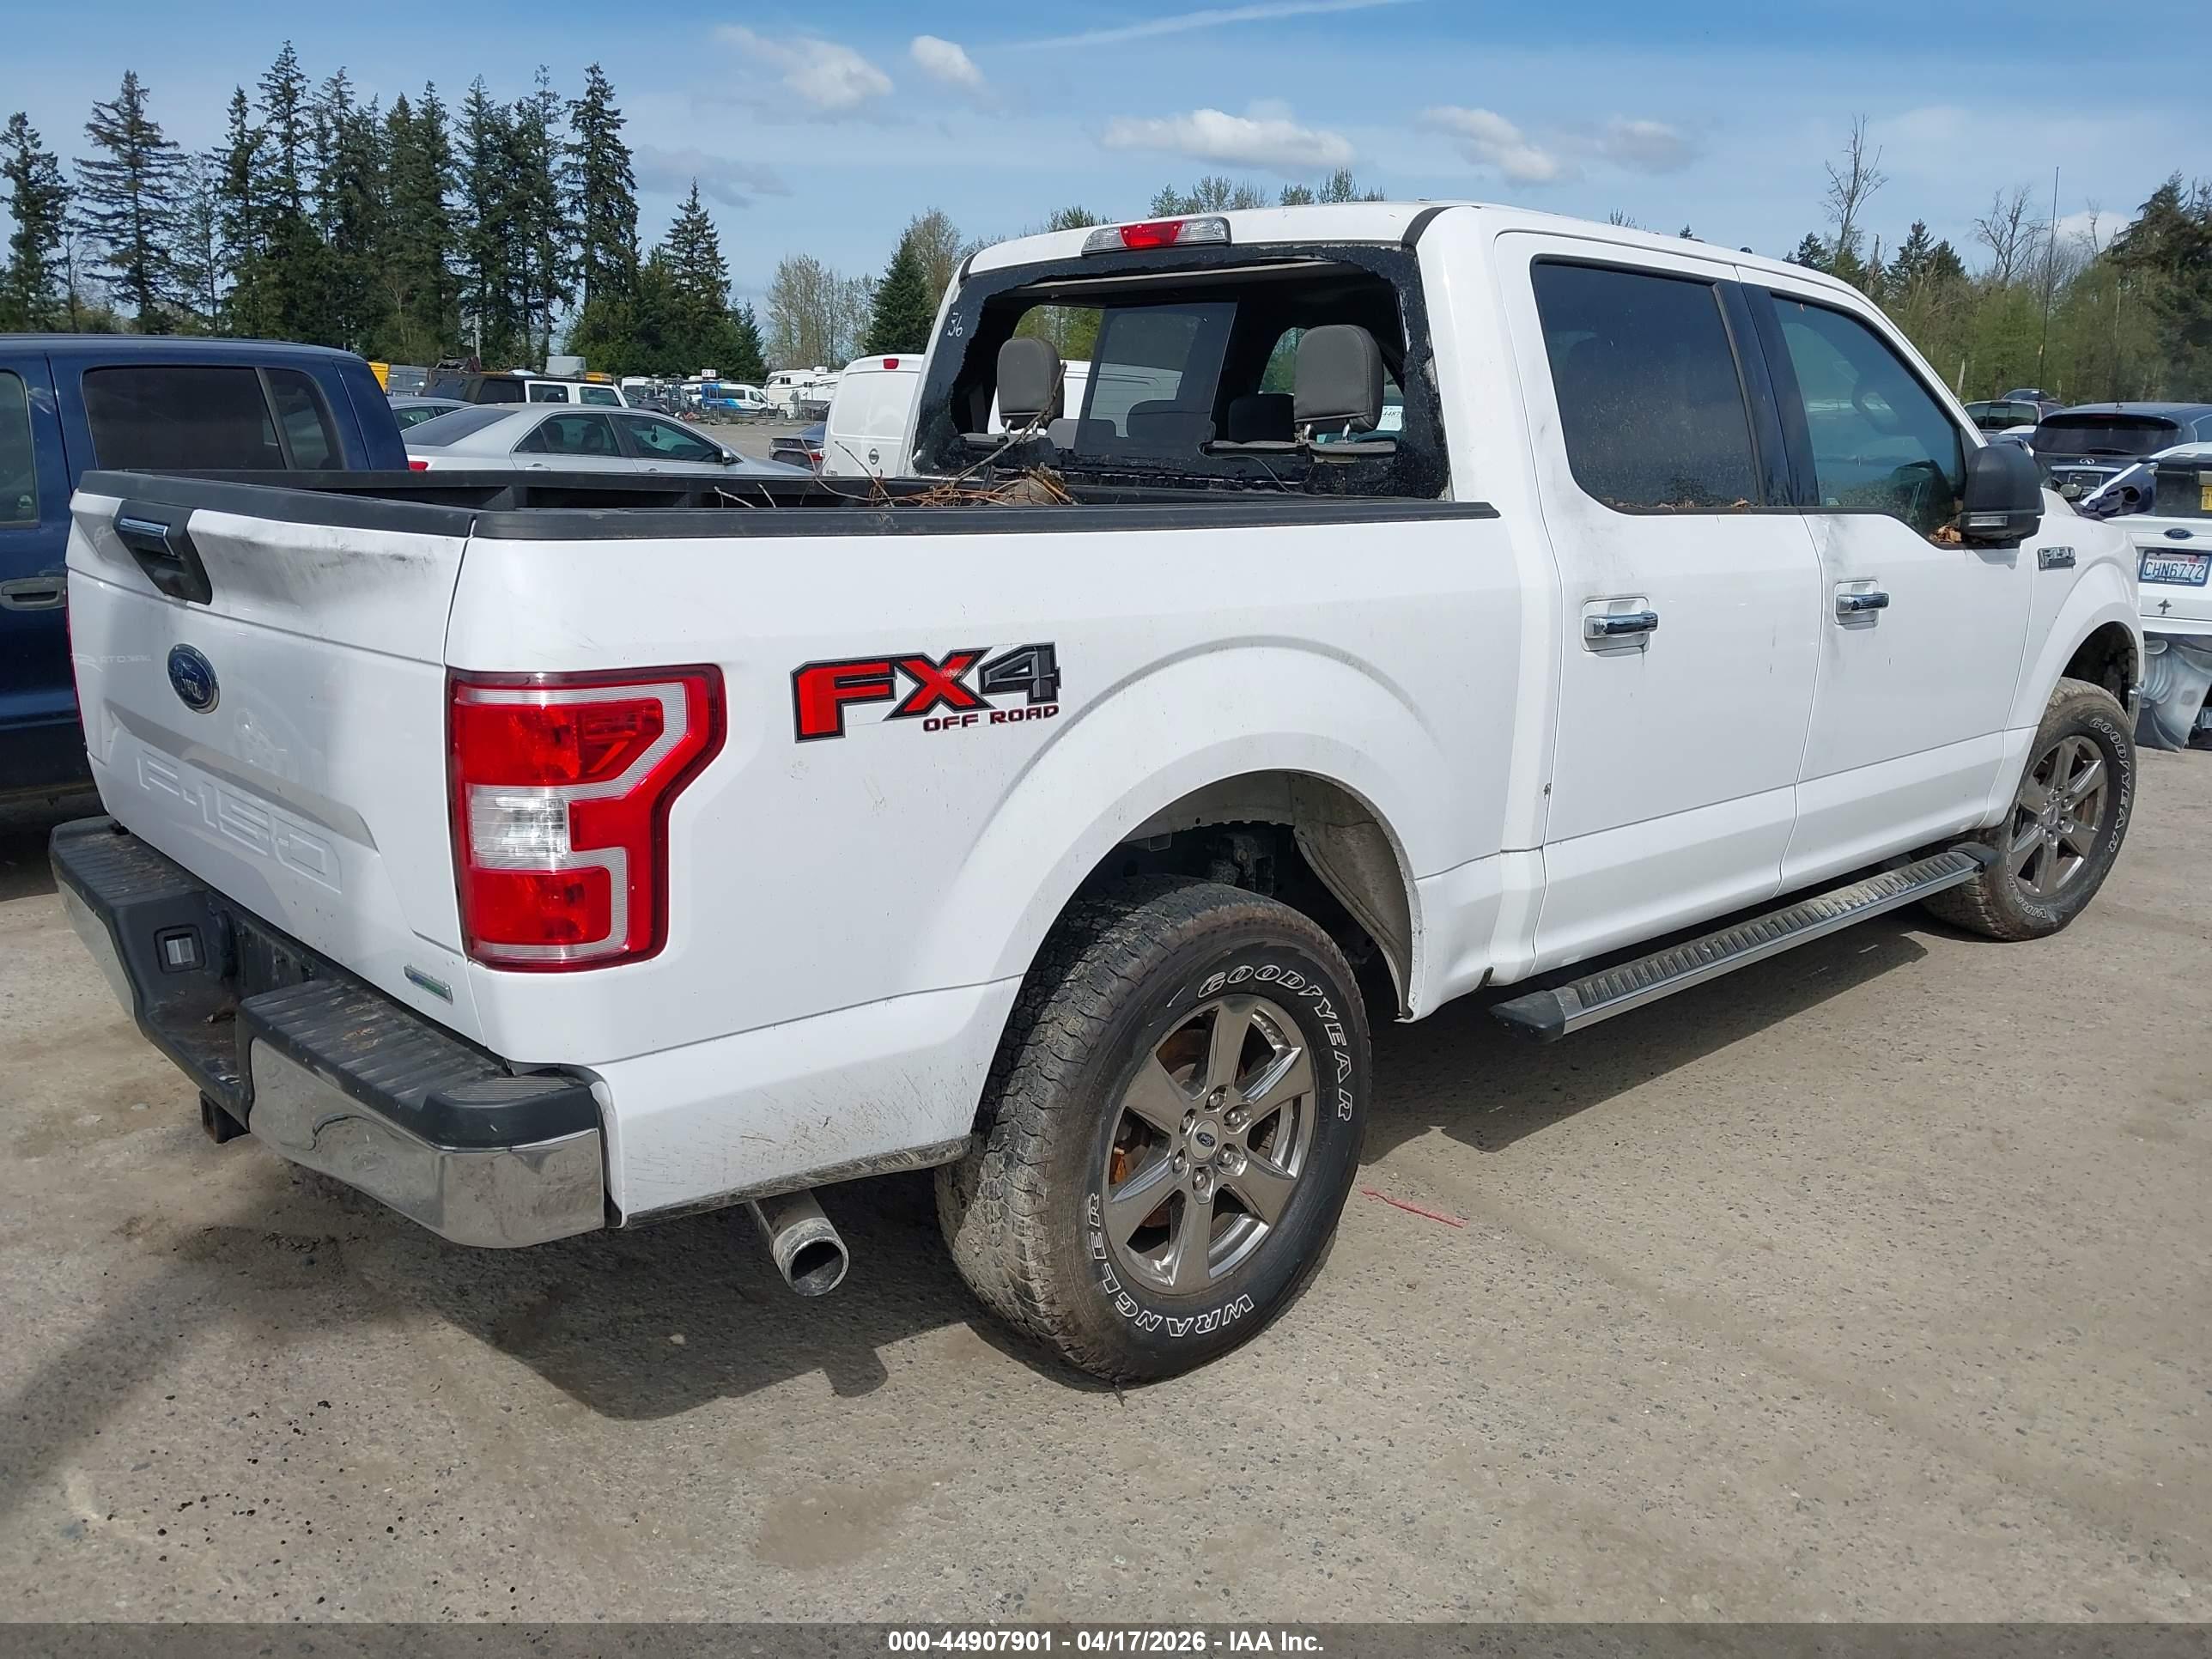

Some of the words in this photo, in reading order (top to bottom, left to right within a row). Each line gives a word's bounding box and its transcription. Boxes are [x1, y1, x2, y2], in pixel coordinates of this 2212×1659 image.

[2144, 562, 2205, 580] CHN6772
[790, 641, 1061, 744] FX4
[922, 713, 979, 732] OFF
[989, 704, 1060, 726] ROAD
[2089, 718, 2130, 853] GOODYEAR
[1198, 965, 1353, 1122] GOODYEAR
[1088, 1193, 1255, 1337] WRANGLER
